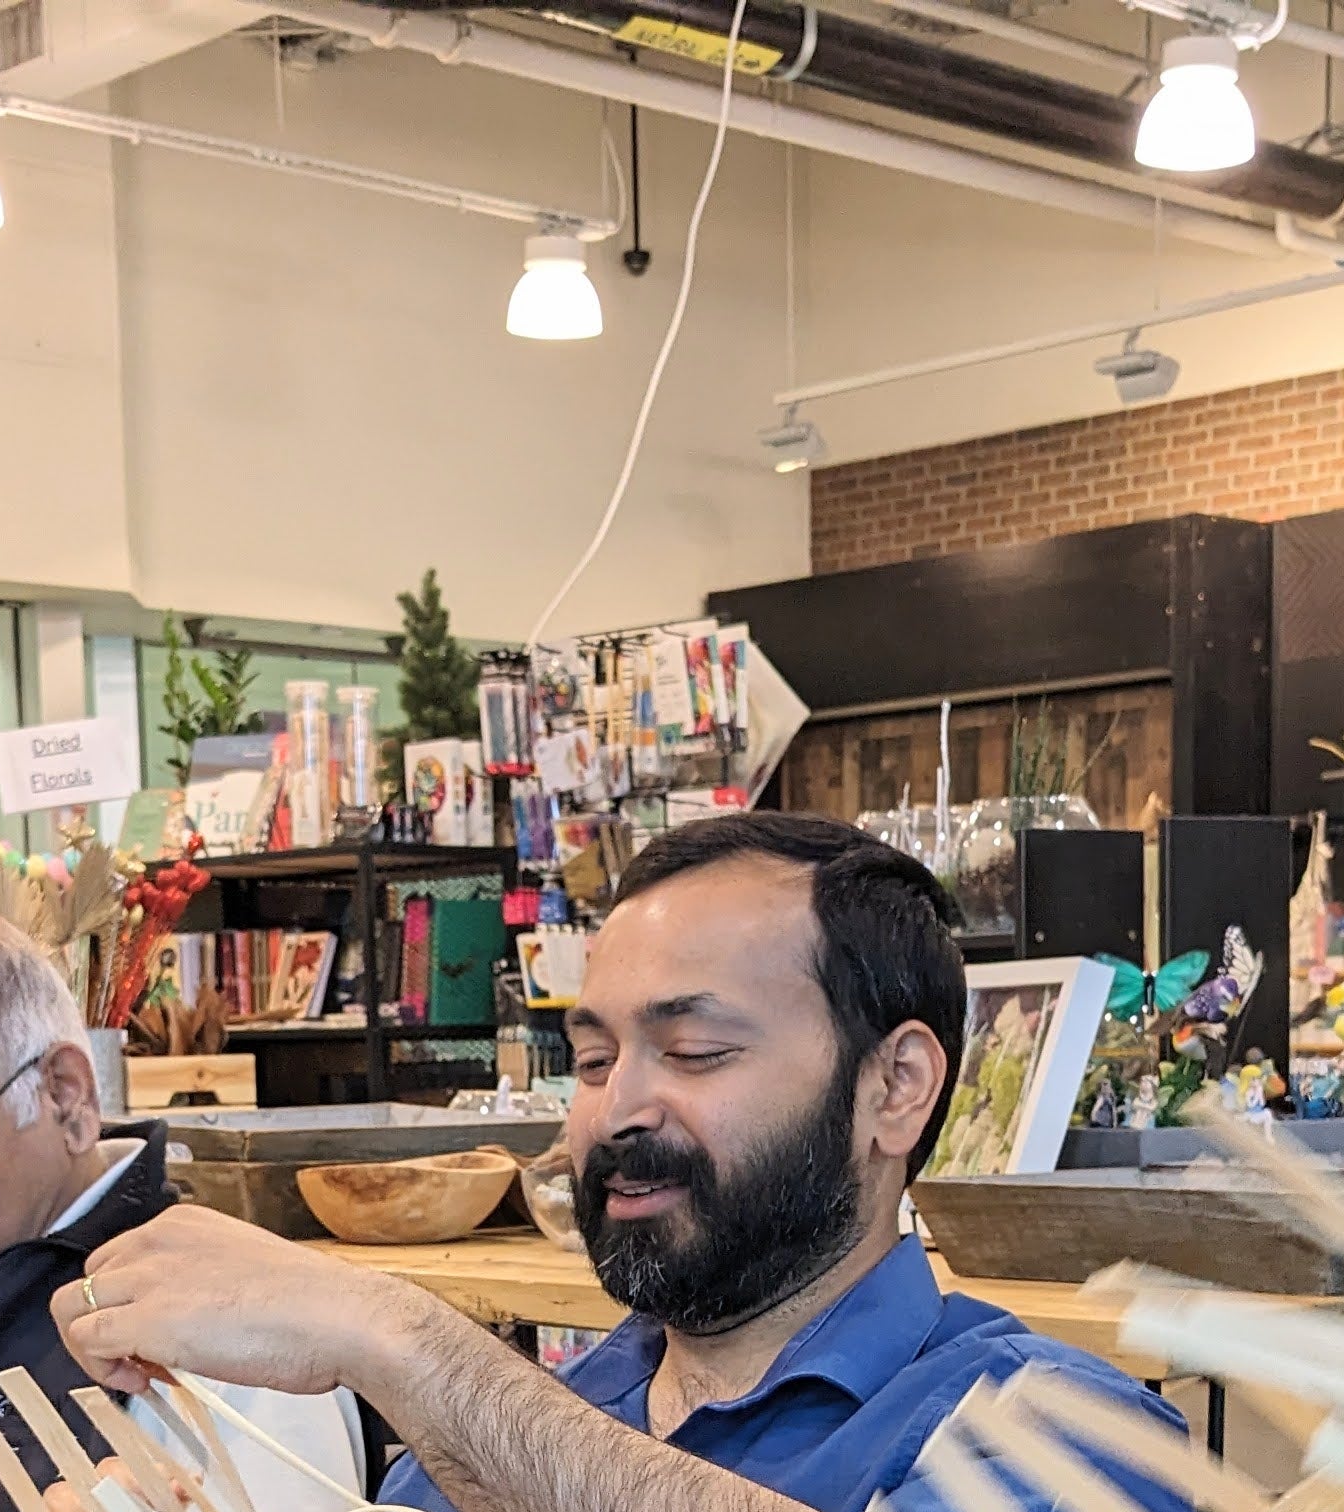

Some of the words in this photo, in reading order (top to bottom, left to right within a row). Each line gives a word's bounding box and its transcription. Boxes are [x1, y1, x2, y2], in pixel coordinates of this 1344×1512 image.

[32, 733, 82, 757] Dried
[31, 768, 93, 793] Florals
[195, 800, 250, 834] Par
